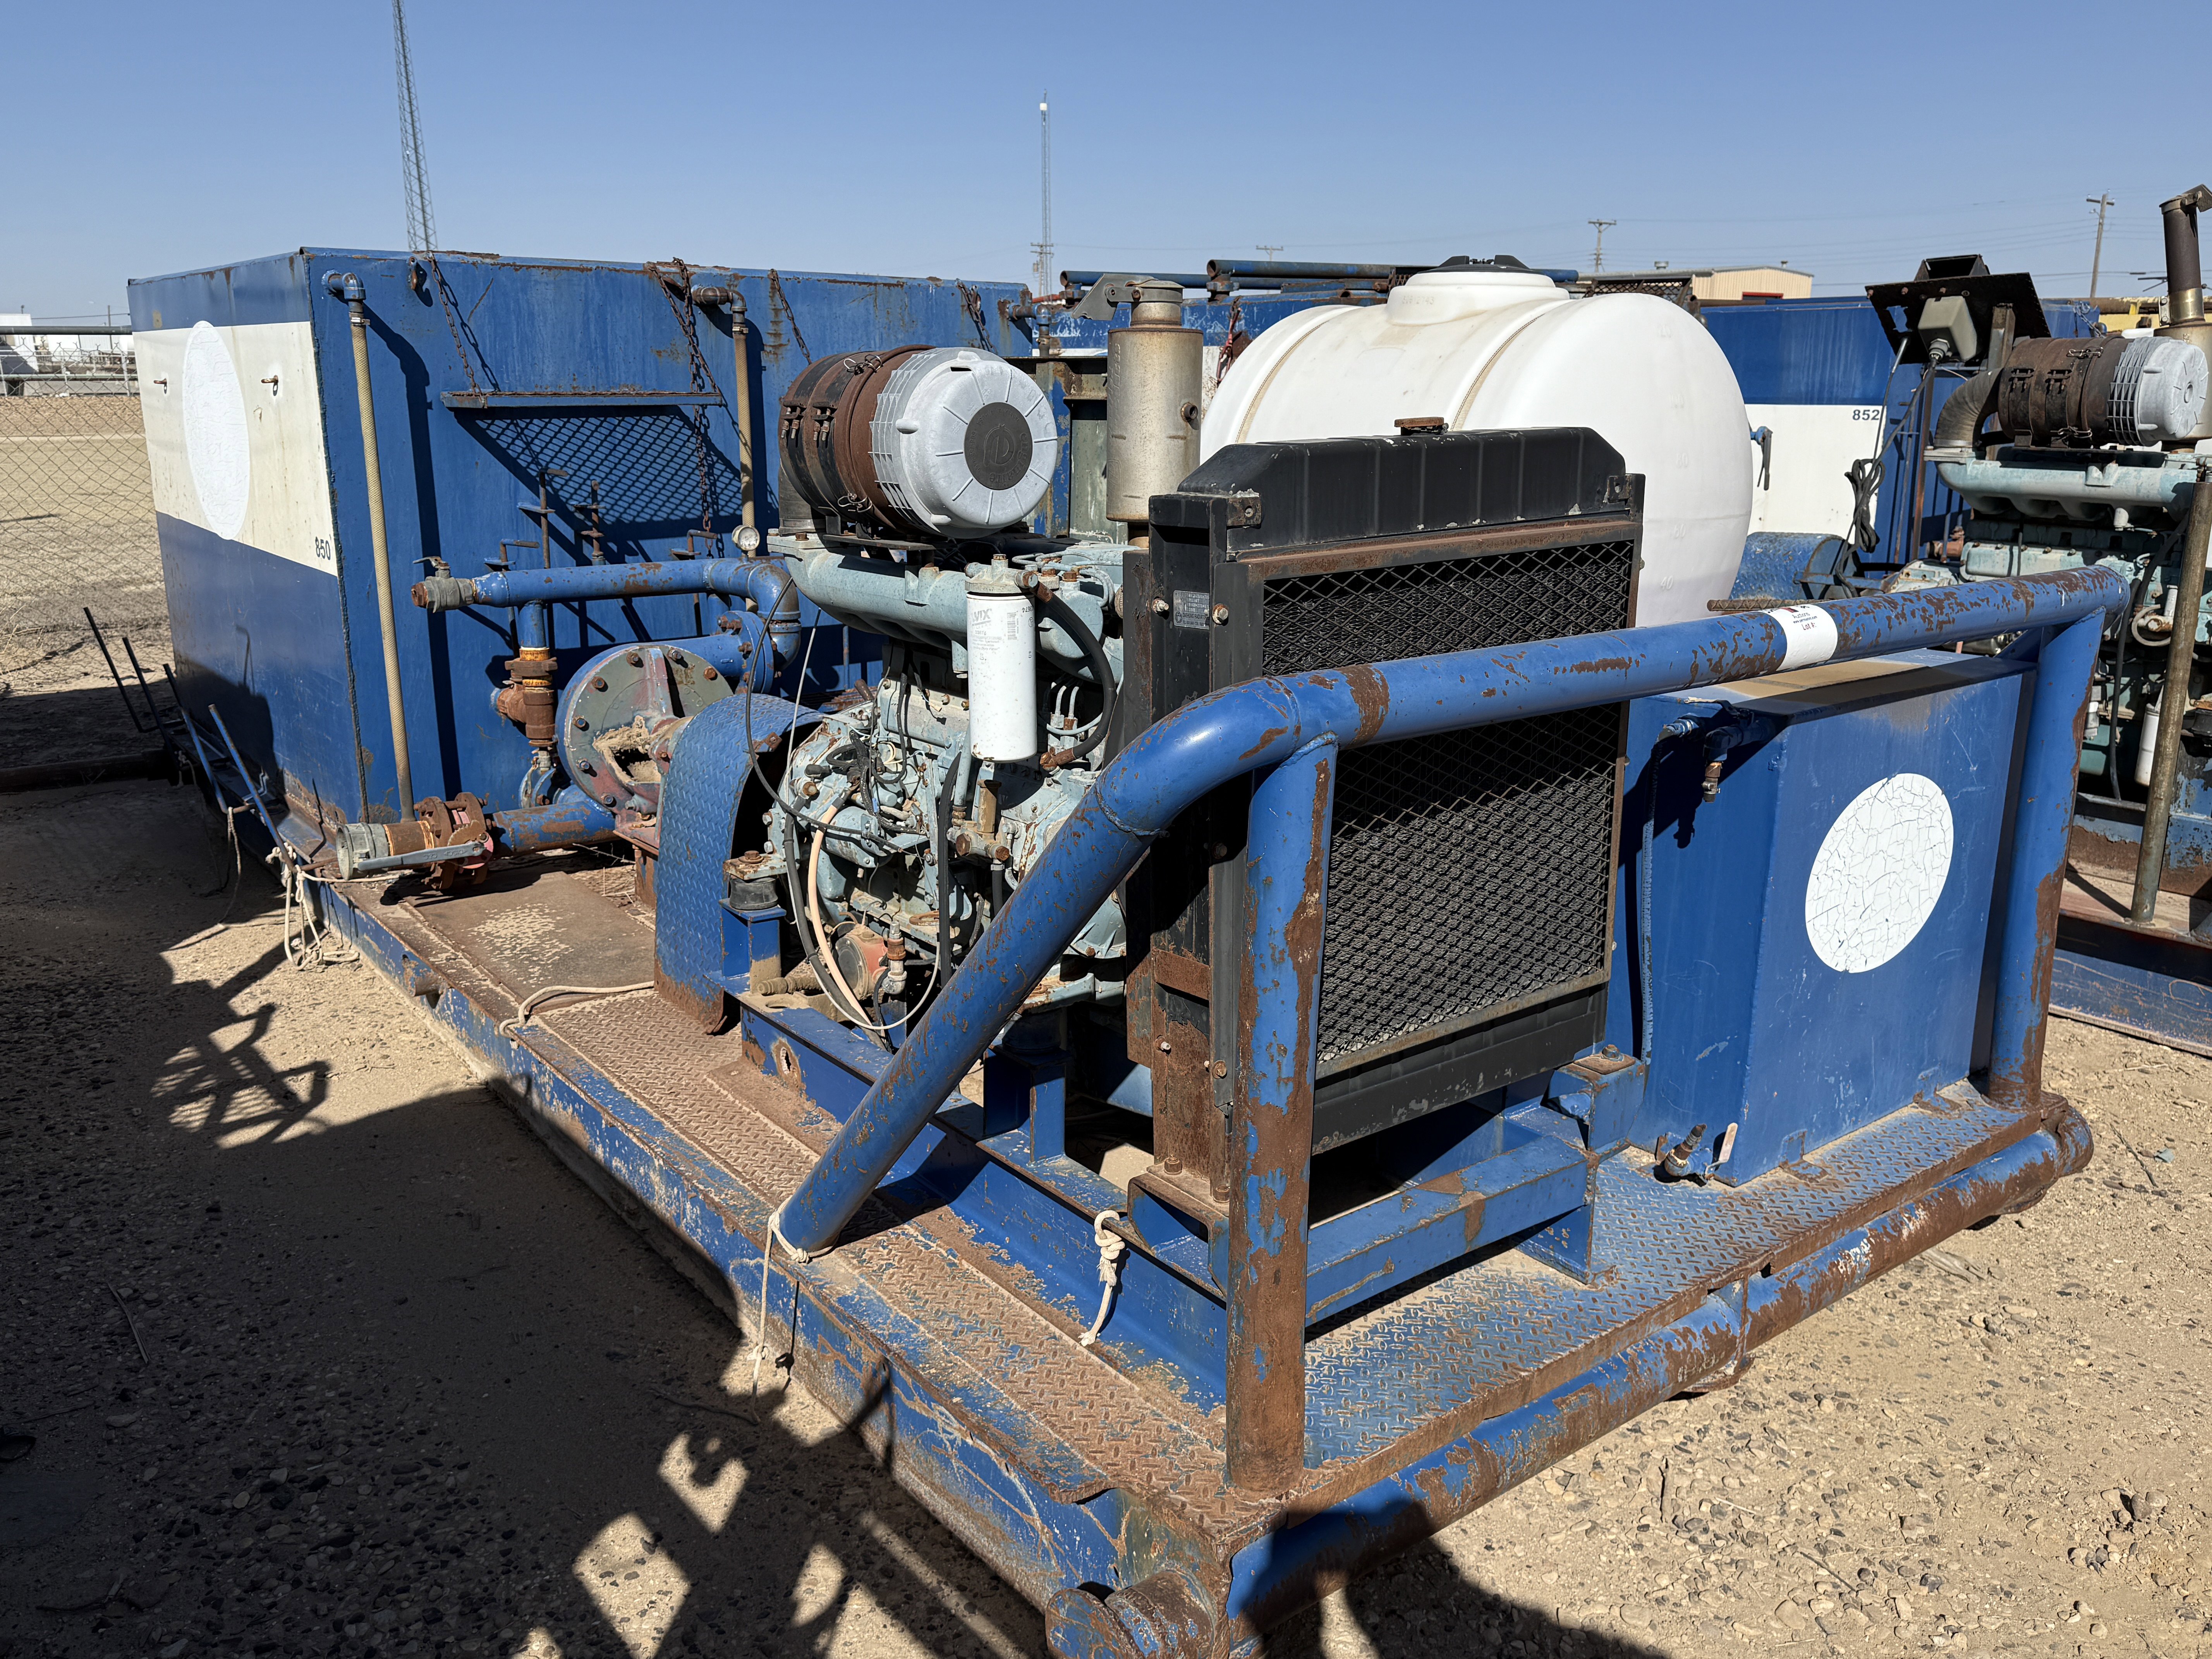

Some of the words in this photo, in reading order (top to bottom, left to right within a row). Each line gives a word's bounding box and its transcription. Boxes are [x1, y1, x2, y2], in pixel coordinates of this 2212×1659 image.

[1852, 409, 1880, 421] 852
[1676, 452, 1689, 468] 80
[1674, 524, 1686, 539] 60
[315, 536, 331, 560] 850
[1660, 575, 1673, 590] 40
